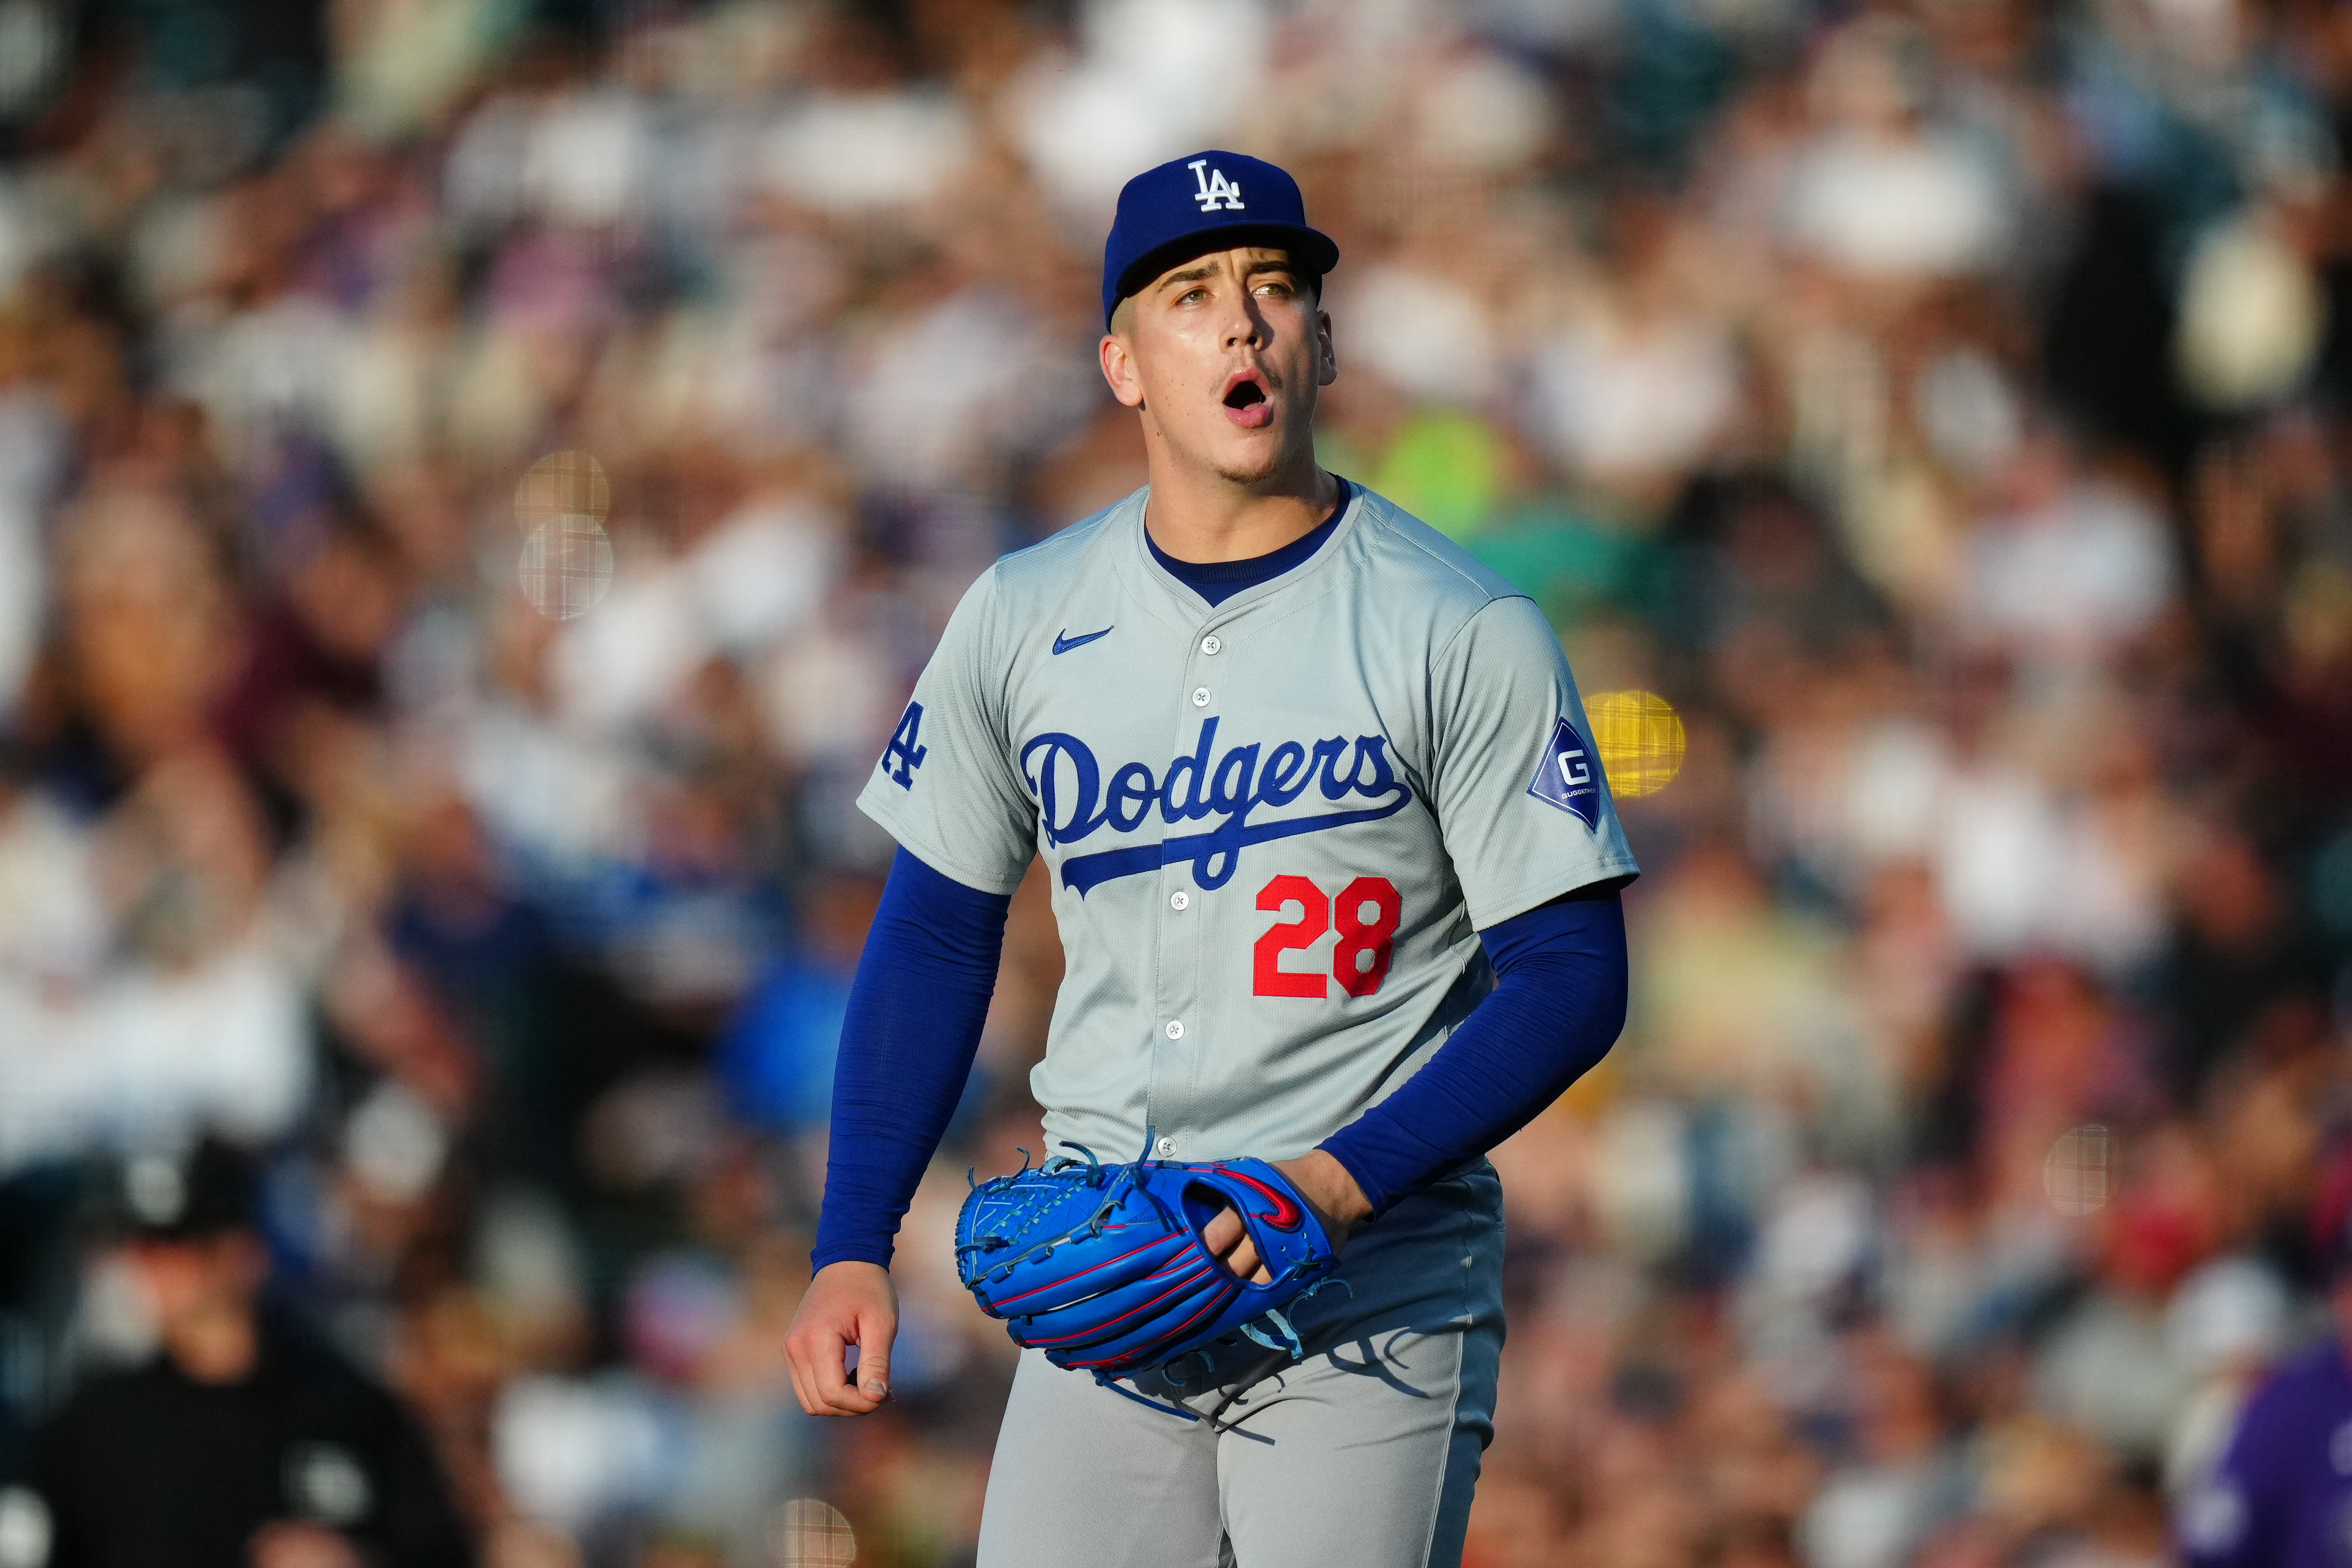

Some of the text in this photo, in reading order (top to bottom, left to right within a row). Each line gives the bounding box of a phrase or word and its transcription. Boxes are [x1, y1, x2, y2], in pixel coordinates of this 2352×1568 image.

[1187, 159, 1245, 212] LA
[1557, 749, 1591, 786] G
[1561, 788, 1596, 799] GUGGENHE
[1020, 716, 1412, 890] Dodgers
[1253, 874, 1400, 998] 28
